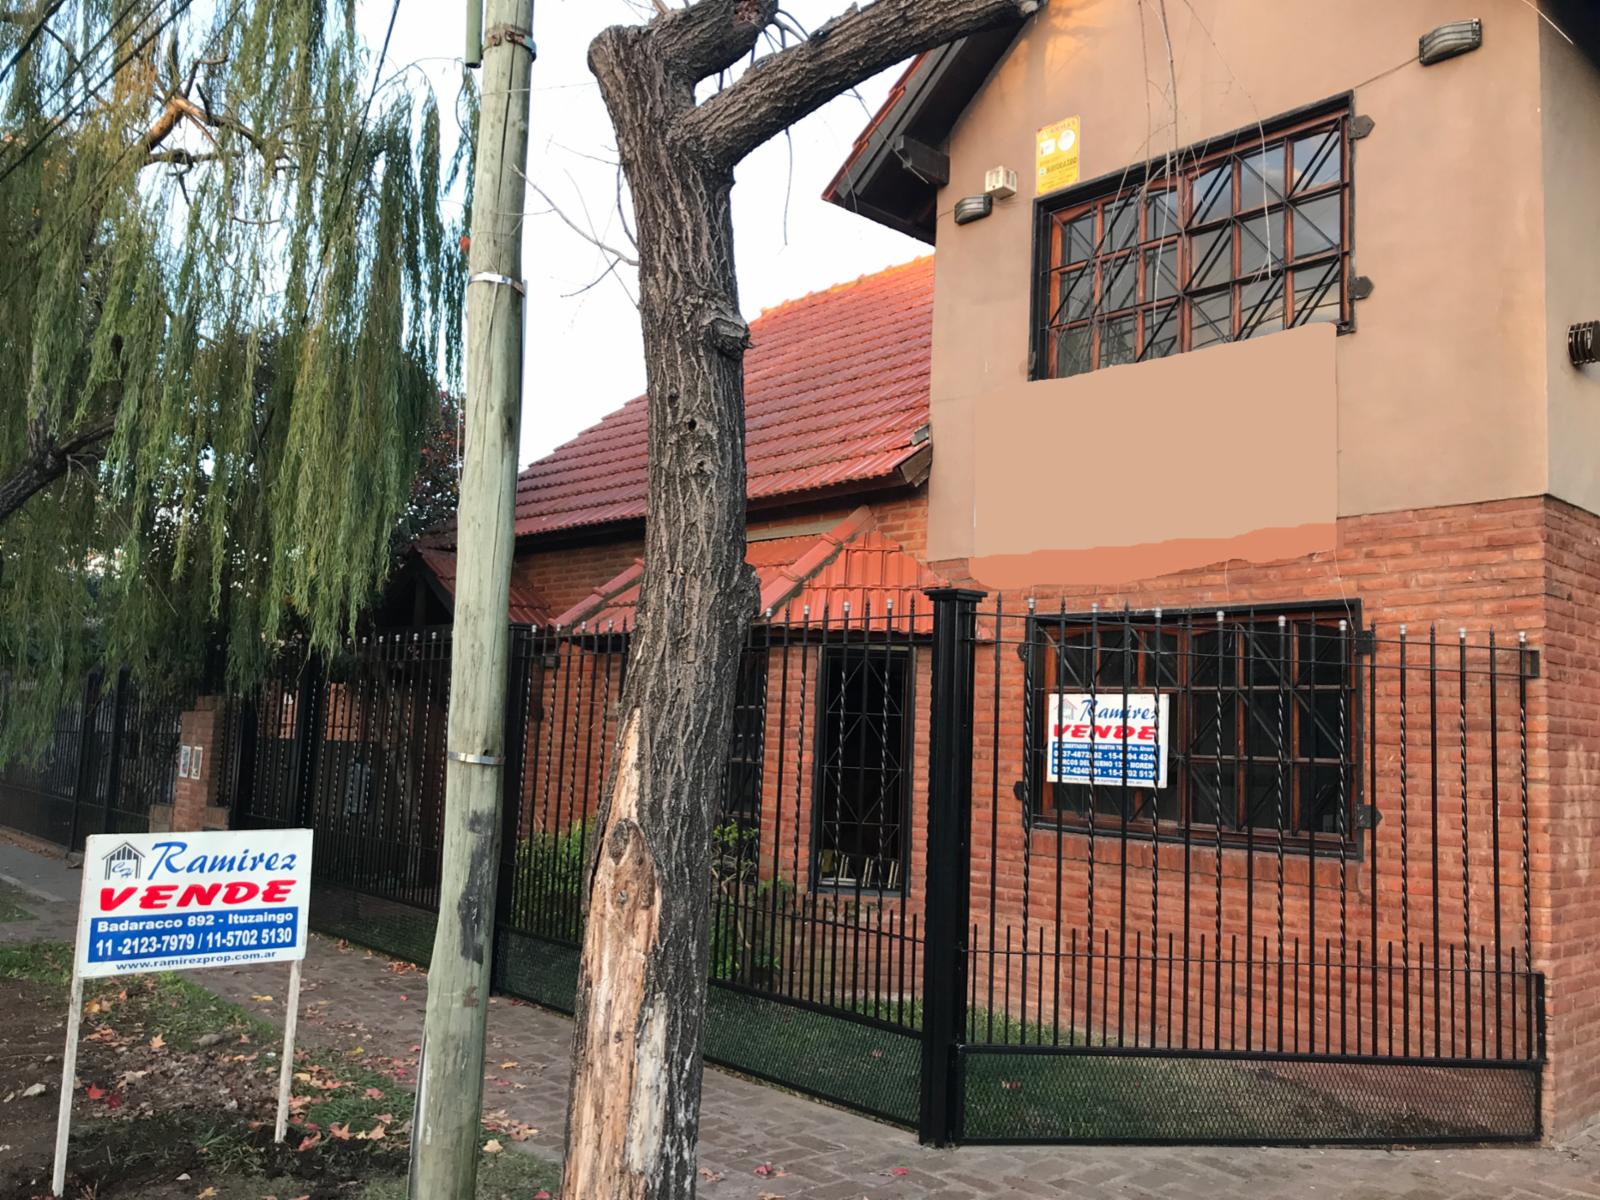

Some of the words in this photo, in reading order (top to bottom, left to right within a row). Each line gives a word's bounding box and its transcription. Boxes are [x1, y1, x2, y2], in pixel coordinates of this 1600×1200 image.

[1054, 724, 1157, 740] VENDE
[147, 841, 297, 880] Ramirez
[100, 880, 297, 911] VENDE
[97, 919, 183, 933] Badaracco
[187, 914, 215, 927] 892
[227, 911, 294, 924] Ituzaingo
[96, 938, 113, 957] 11
[206, 928, 258, 948] 11-5702
[261, 927, 292, 945] 5130
[115, 951, 277, 970] www.ramirezprop.com.ar
